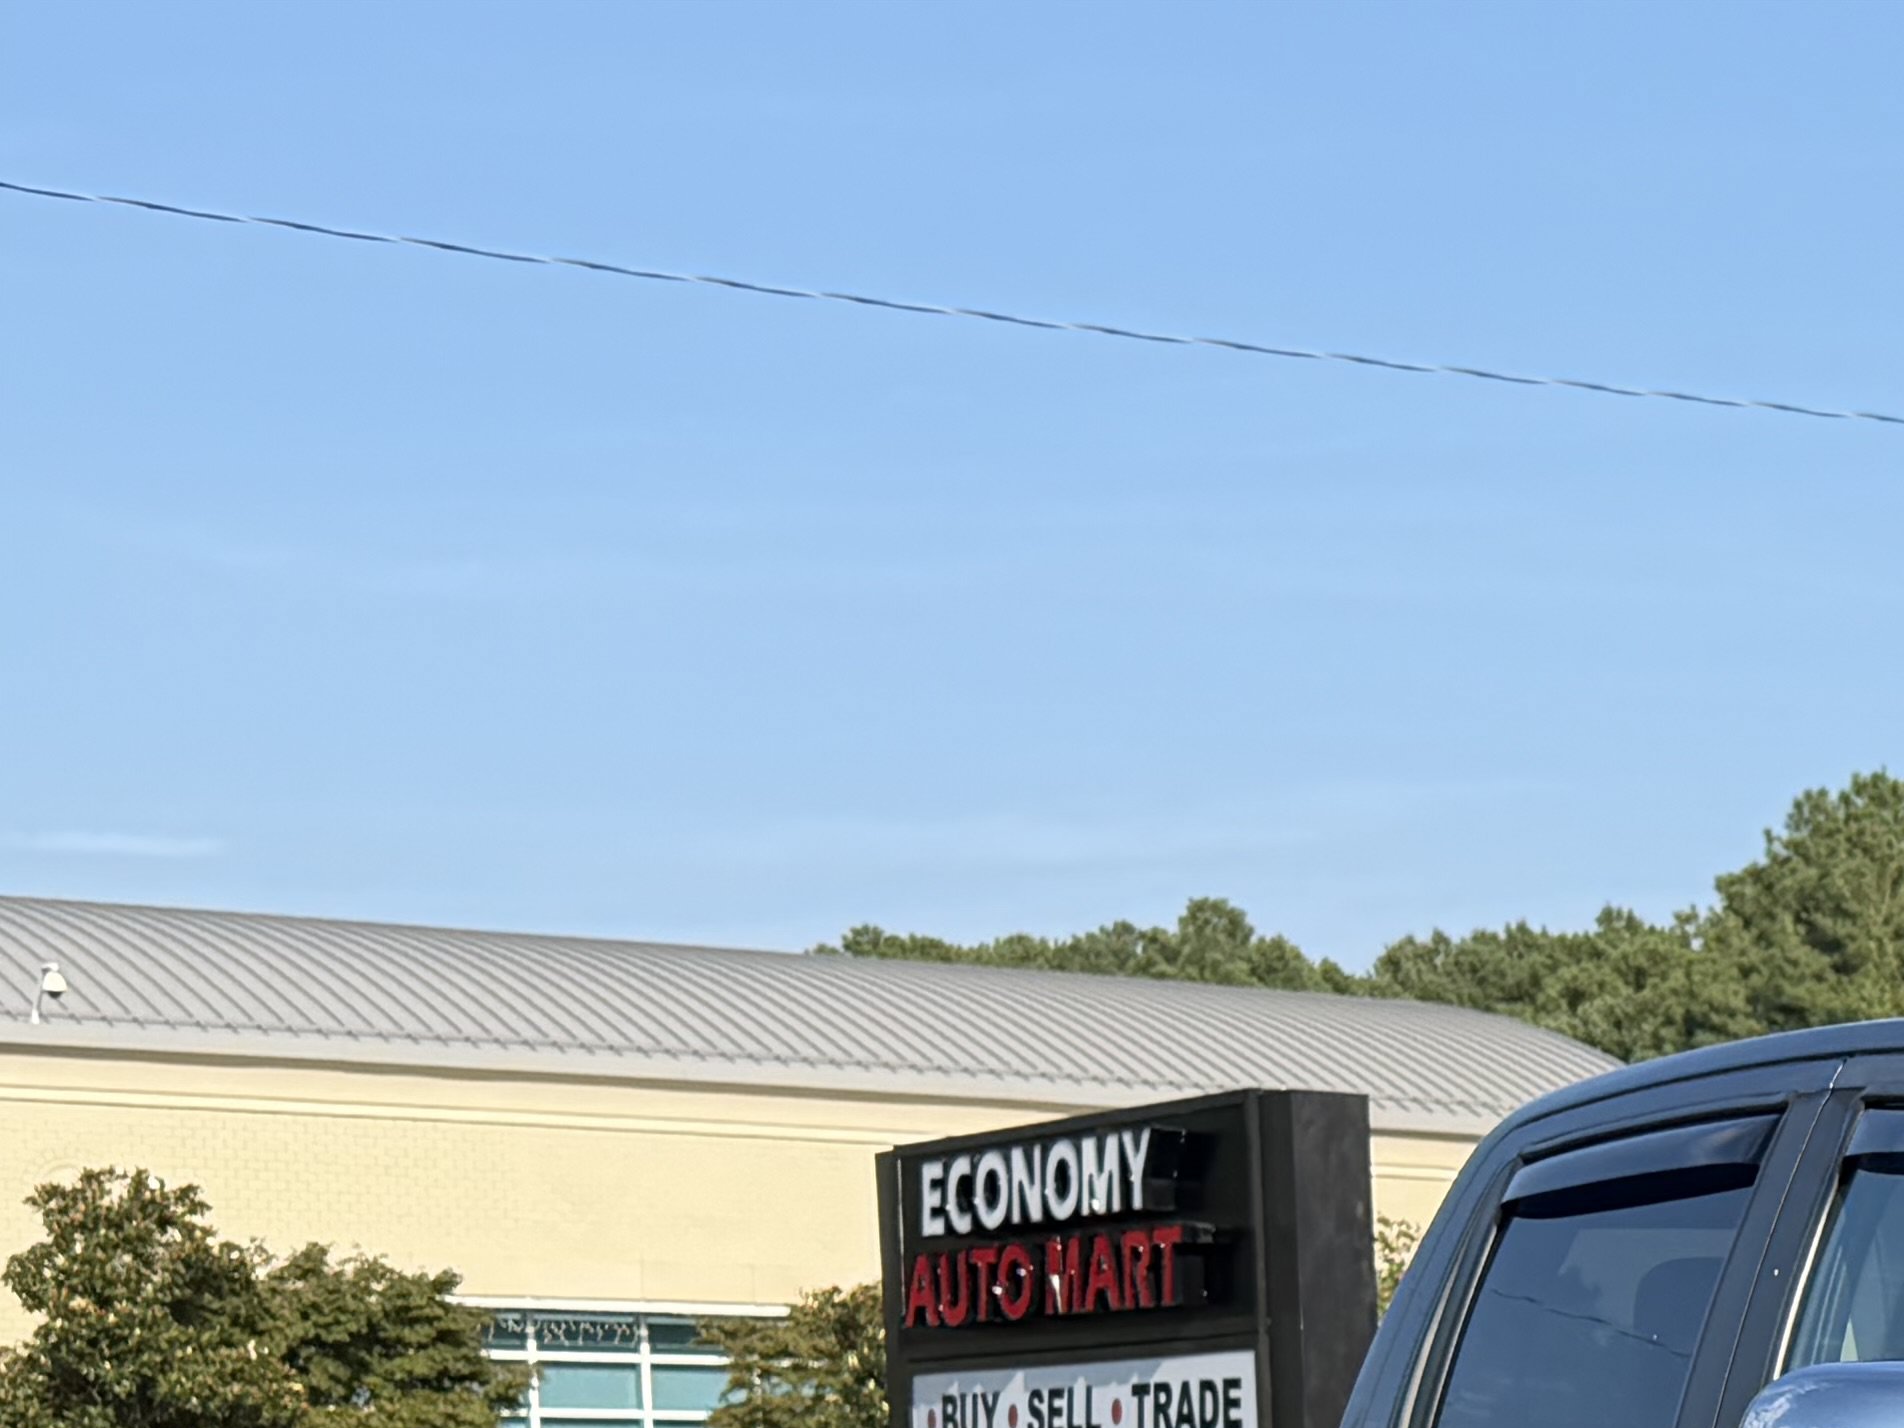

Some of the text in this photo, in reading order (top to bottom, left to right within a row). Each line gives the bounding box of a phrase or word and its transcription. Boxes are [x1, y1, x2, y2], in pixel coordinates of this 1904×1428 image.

[922, 1128, 1151, 1237] ECONOMY
[904, 1225, 1182, 1328] AUTO MART
